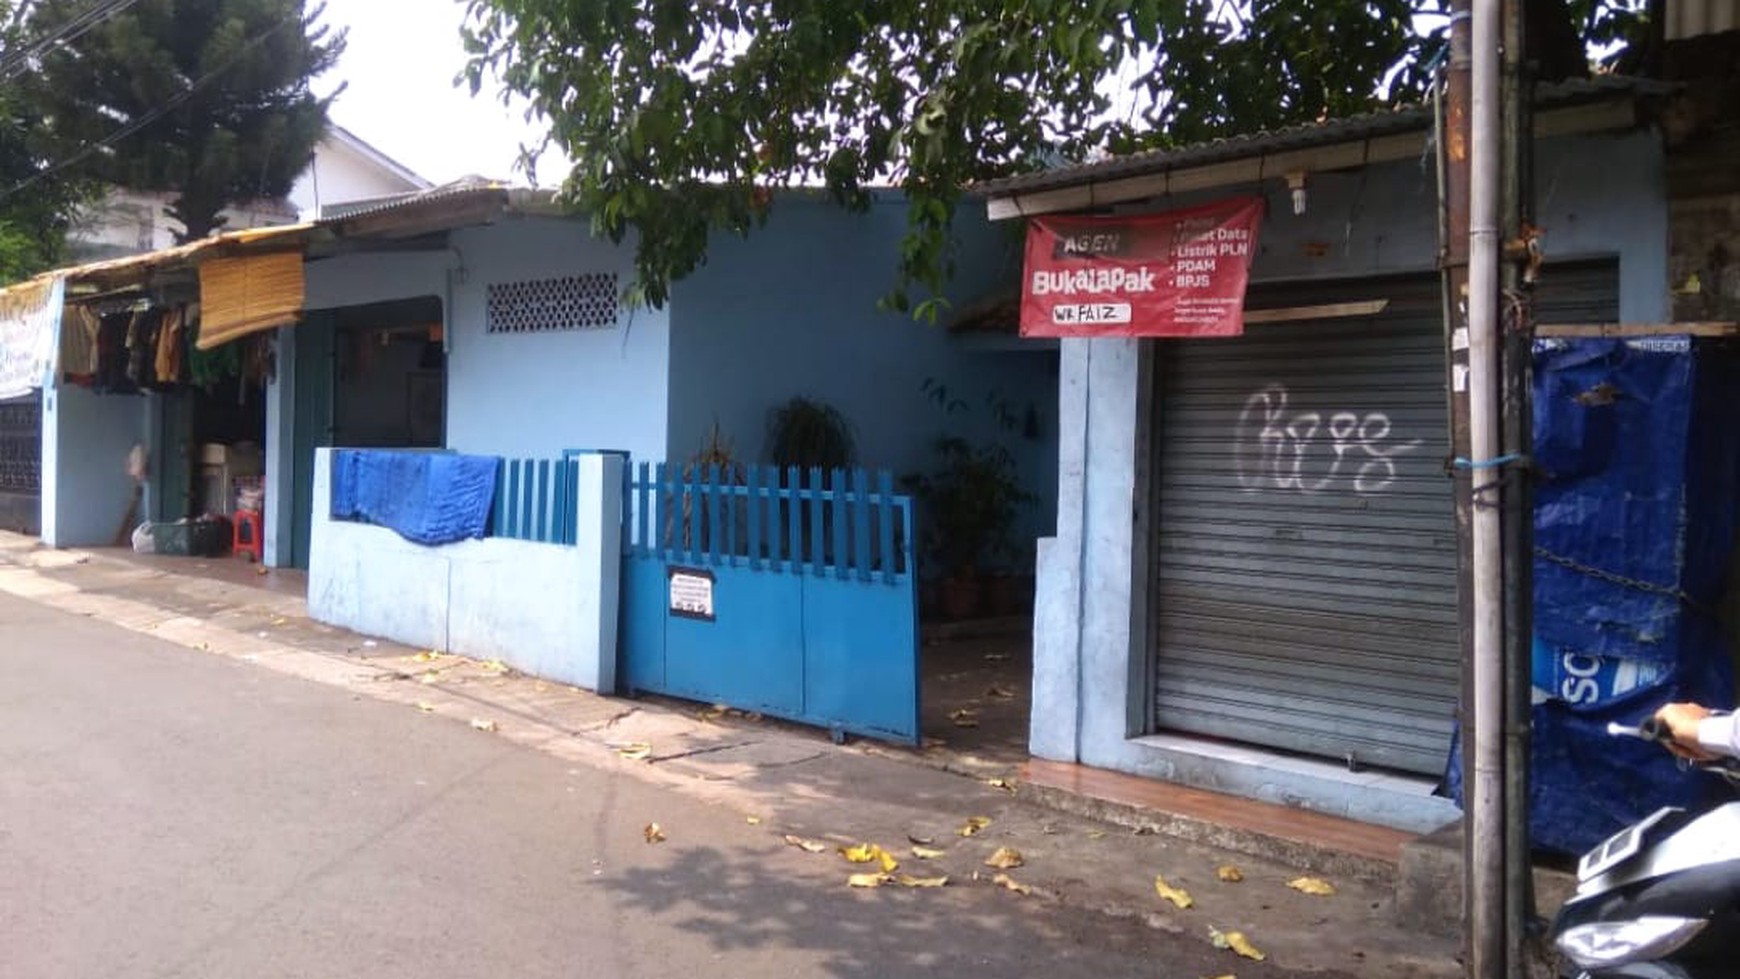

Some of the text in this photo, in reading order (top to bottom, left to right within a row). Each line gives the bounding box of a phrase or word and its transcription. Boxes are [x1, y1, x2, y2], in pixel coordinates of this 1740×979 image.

[1217, 227, 1248, 241] Data
[1063, 234, 1120, 252] AGEN
[1177, 242, 1248, 258] Listrik PLN
[1176, 259, 1216, 272] PDAM
[1176, 274, 1210, 288] BPJS
[1078, 304, 1117, 321] FAIZ
